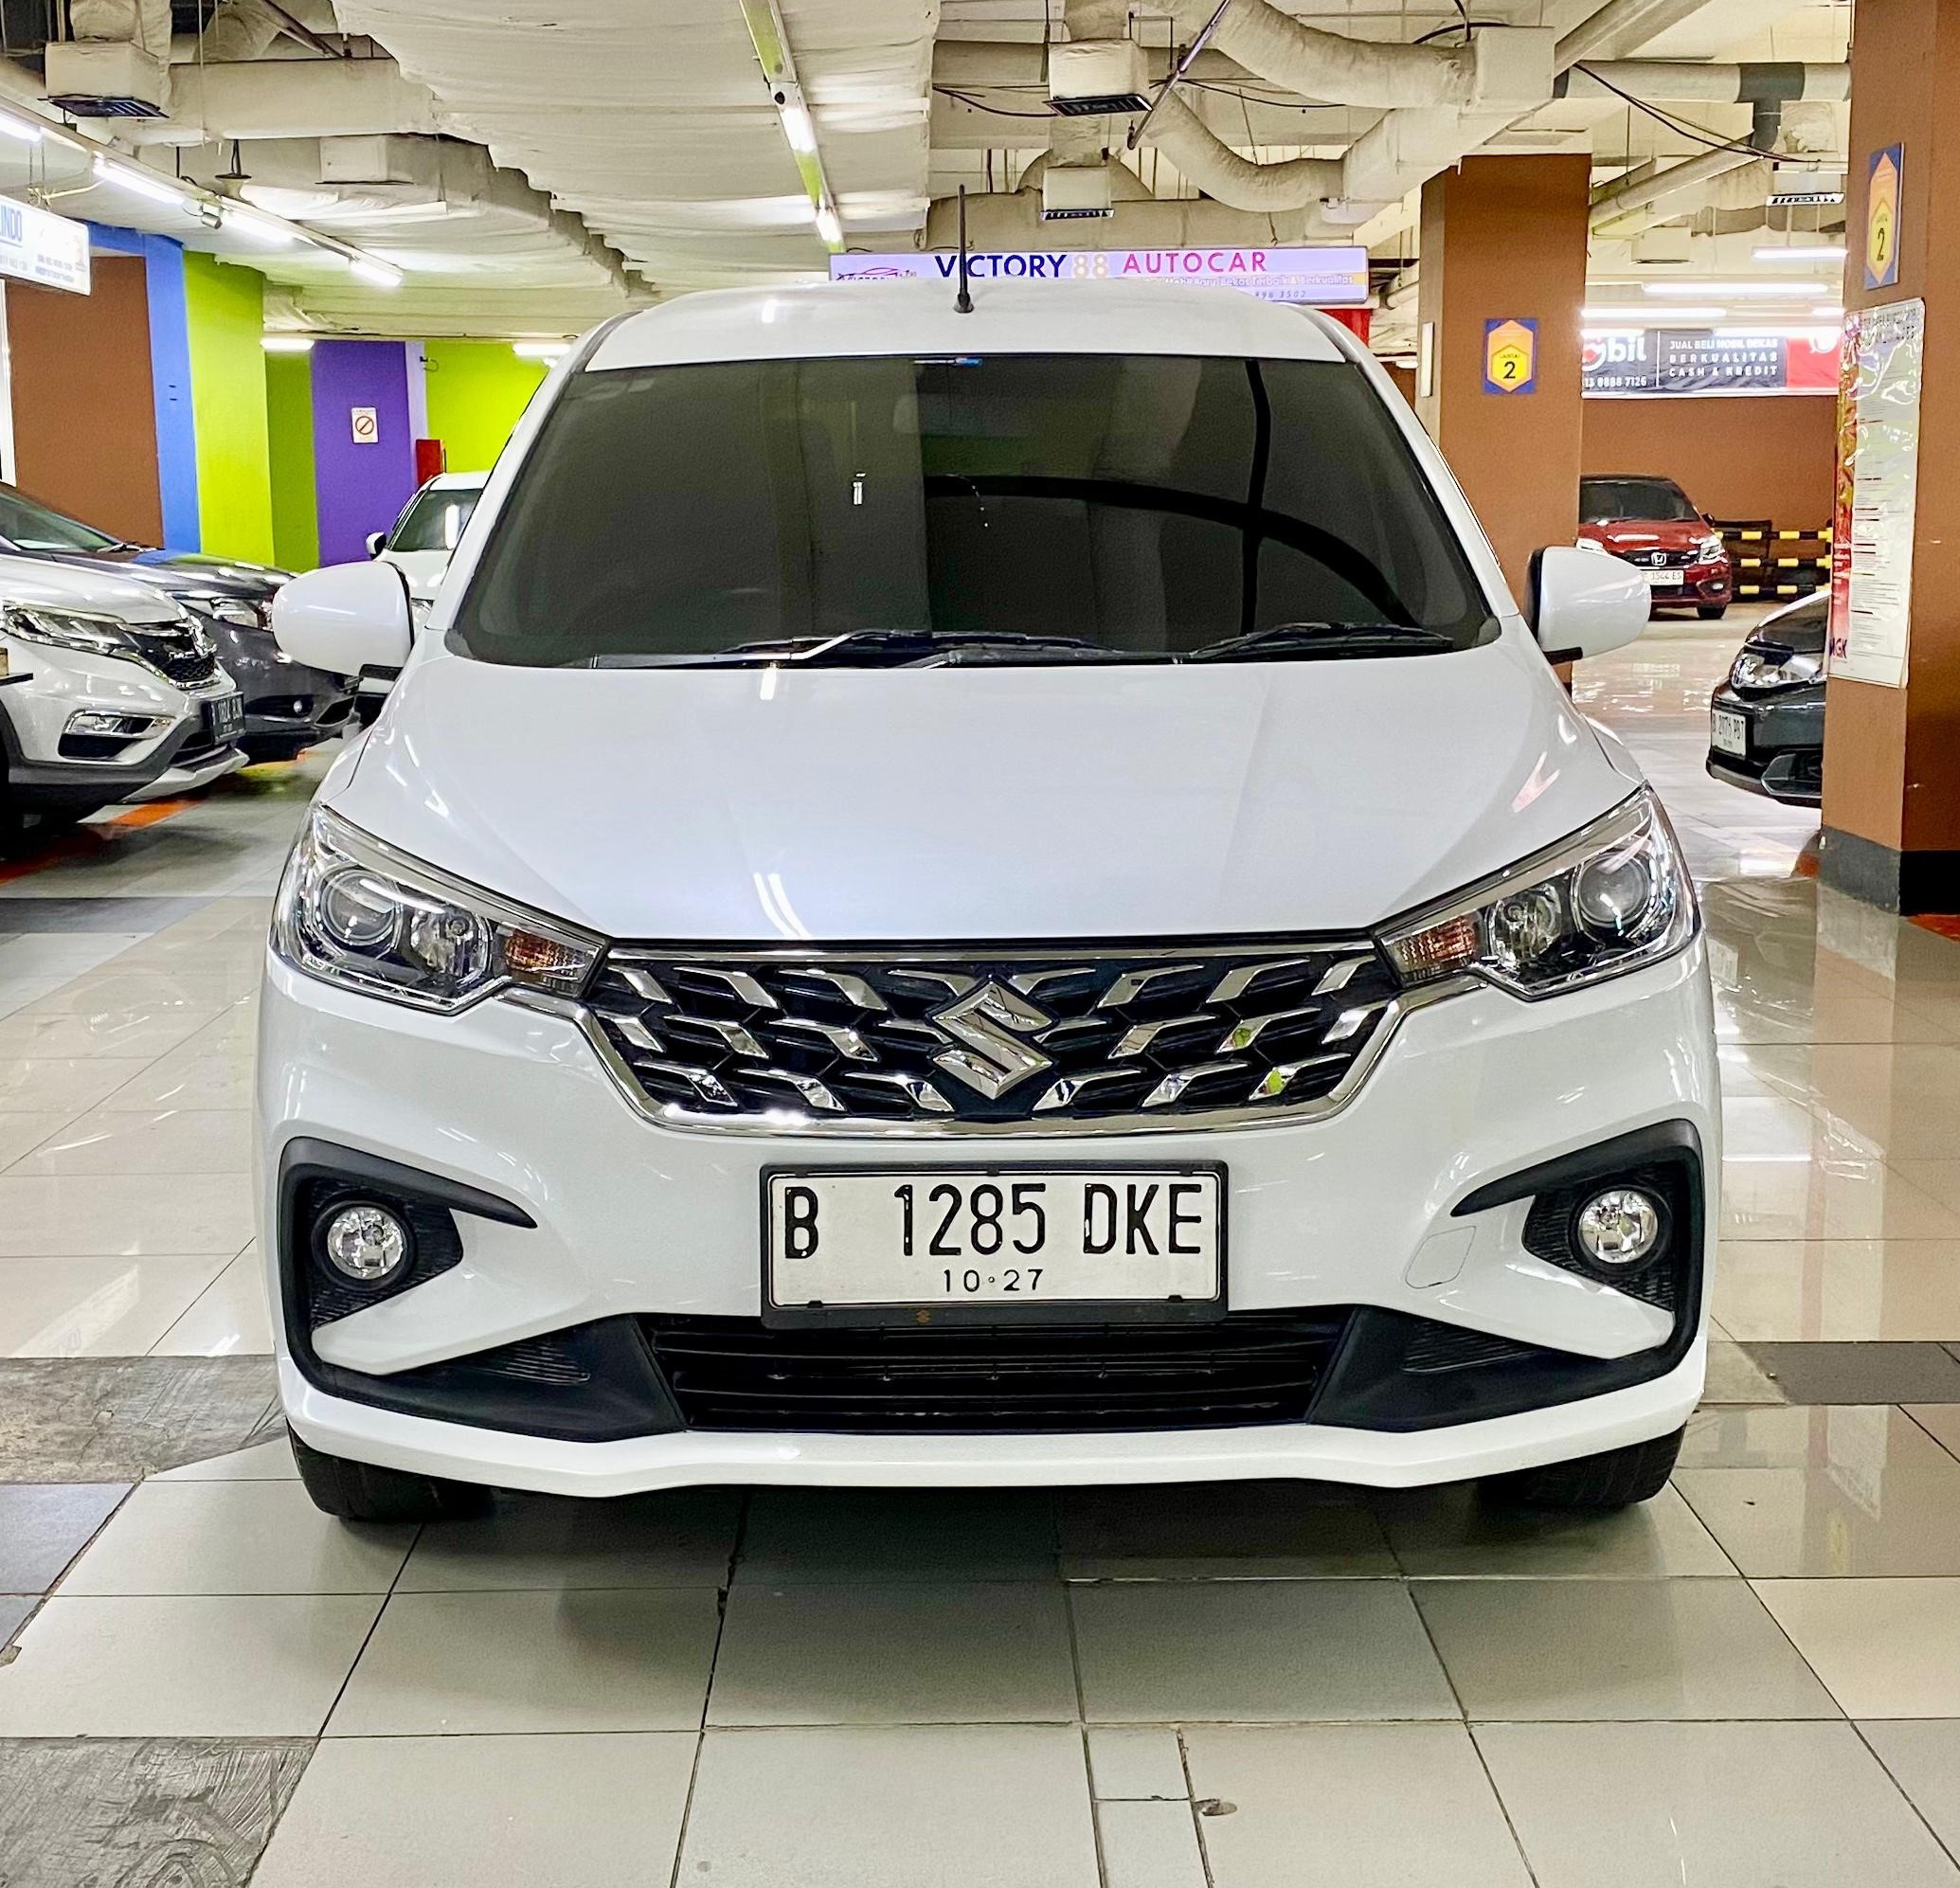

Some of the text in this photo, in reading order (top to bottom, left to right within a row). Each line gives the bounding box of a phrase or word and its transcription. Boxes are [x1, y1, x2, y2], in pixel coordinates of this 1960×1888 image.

[1877, 227, 1885, 261] 2
[934, 251, 1268, 279] VCTORY 88 AUTOCAR
[1669, 340, 1693, 350] JUAL
[1695, 340, 1716, 350] BELI
[1669, 351, 1778, 364] BERKUALITAS
[1503, 361, 1516, 379] 2
[1669, 367, 1705, 377] CASH
[1726, 366, 1778, 377] KREDIT
[1625, 376, 1646, 387] 7126
[785, 1183, 1202, 1259] B 1285 DKE
